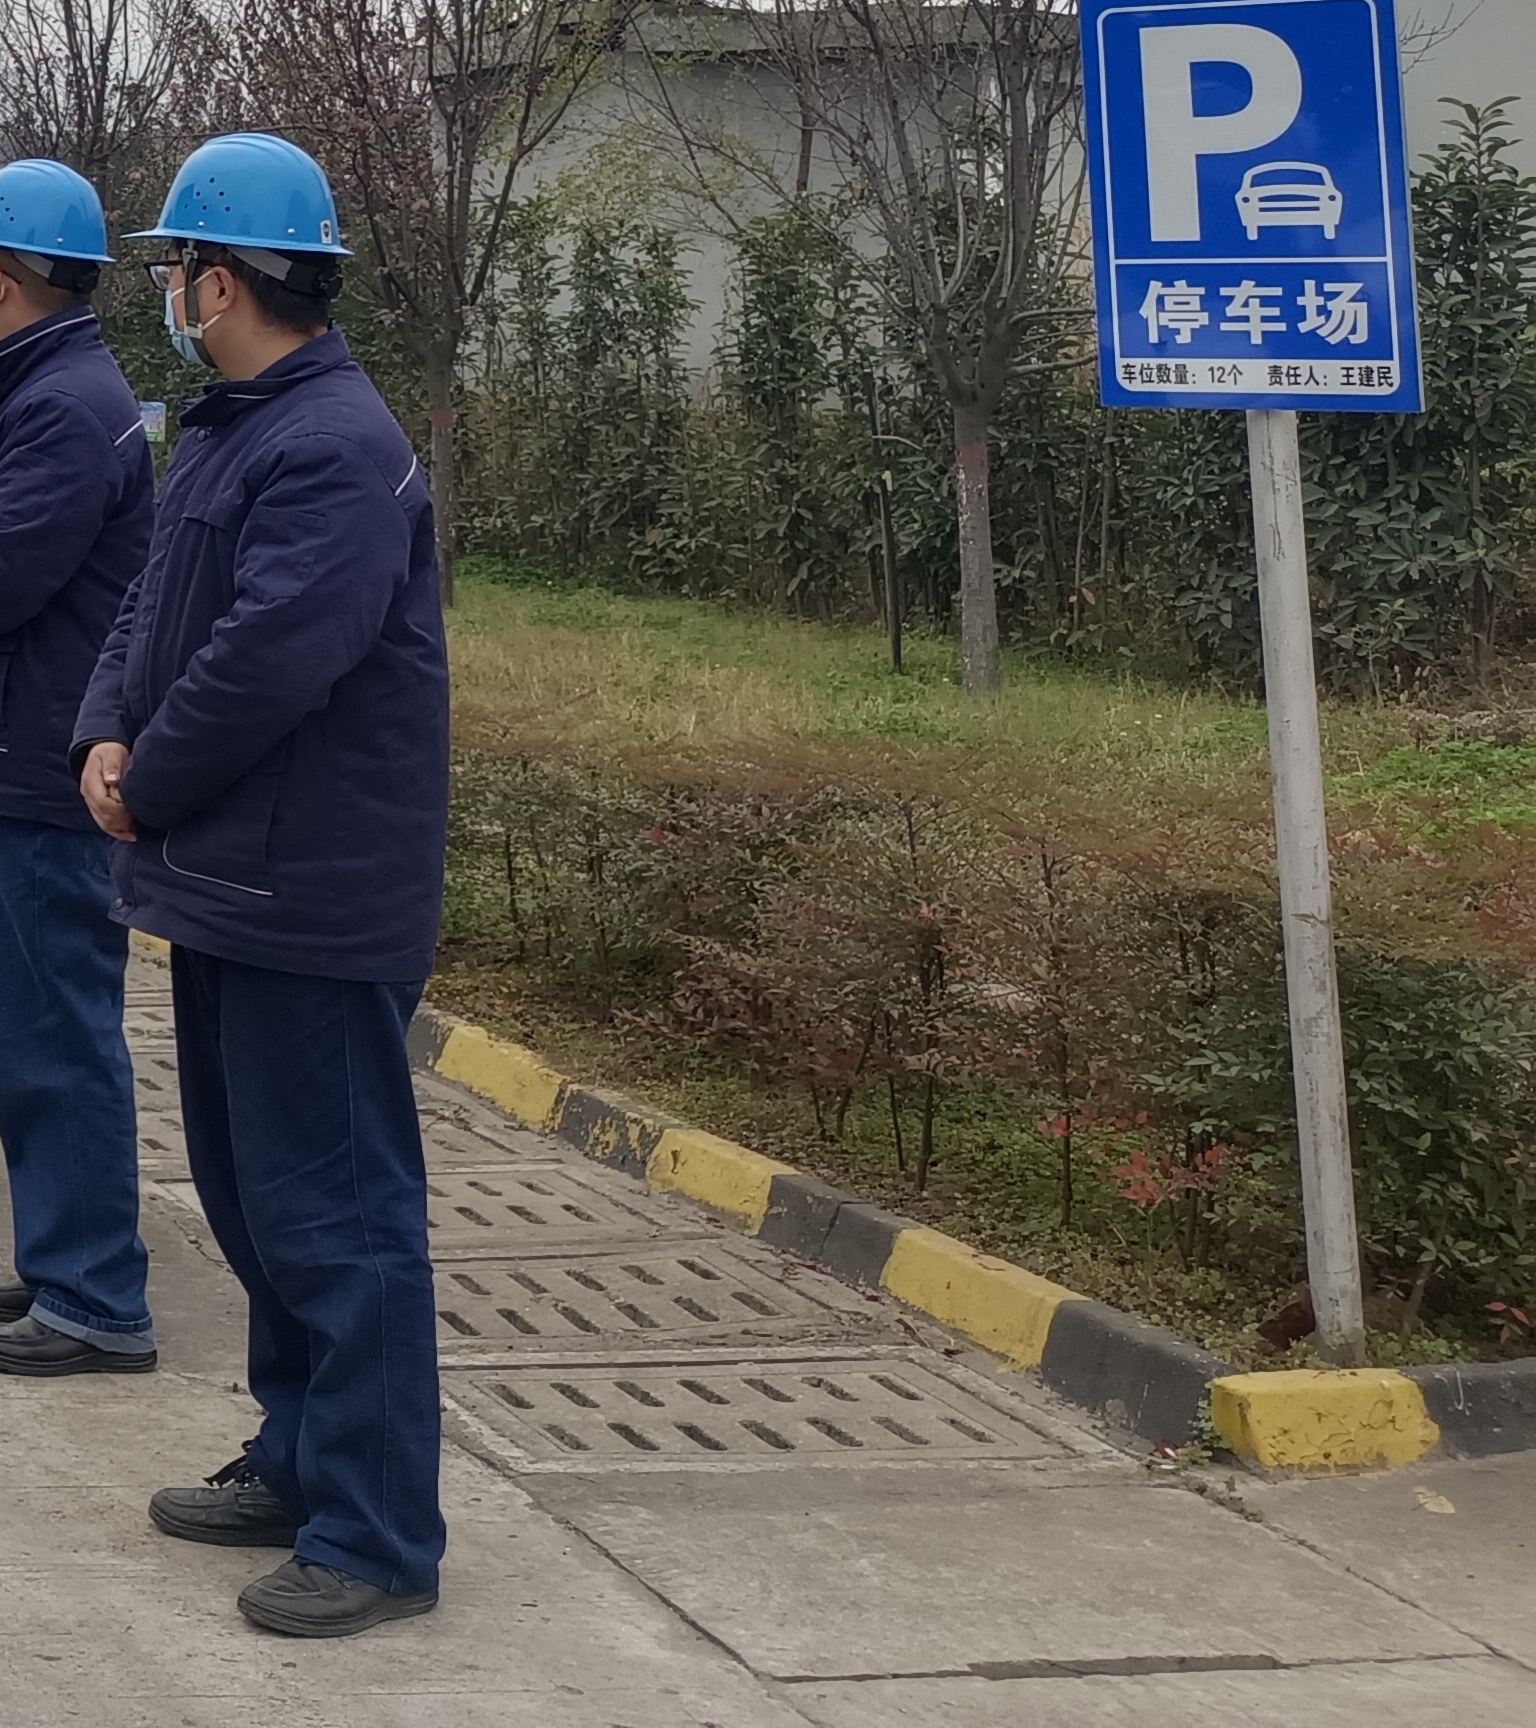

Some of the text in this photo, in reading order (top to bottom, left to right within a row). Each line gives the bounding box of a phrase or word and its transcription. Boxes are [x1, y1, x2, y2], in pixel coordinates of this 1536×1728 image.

[1138, 23, 1303, 243] P
[1139, 279, 1369, 345] 停车场
